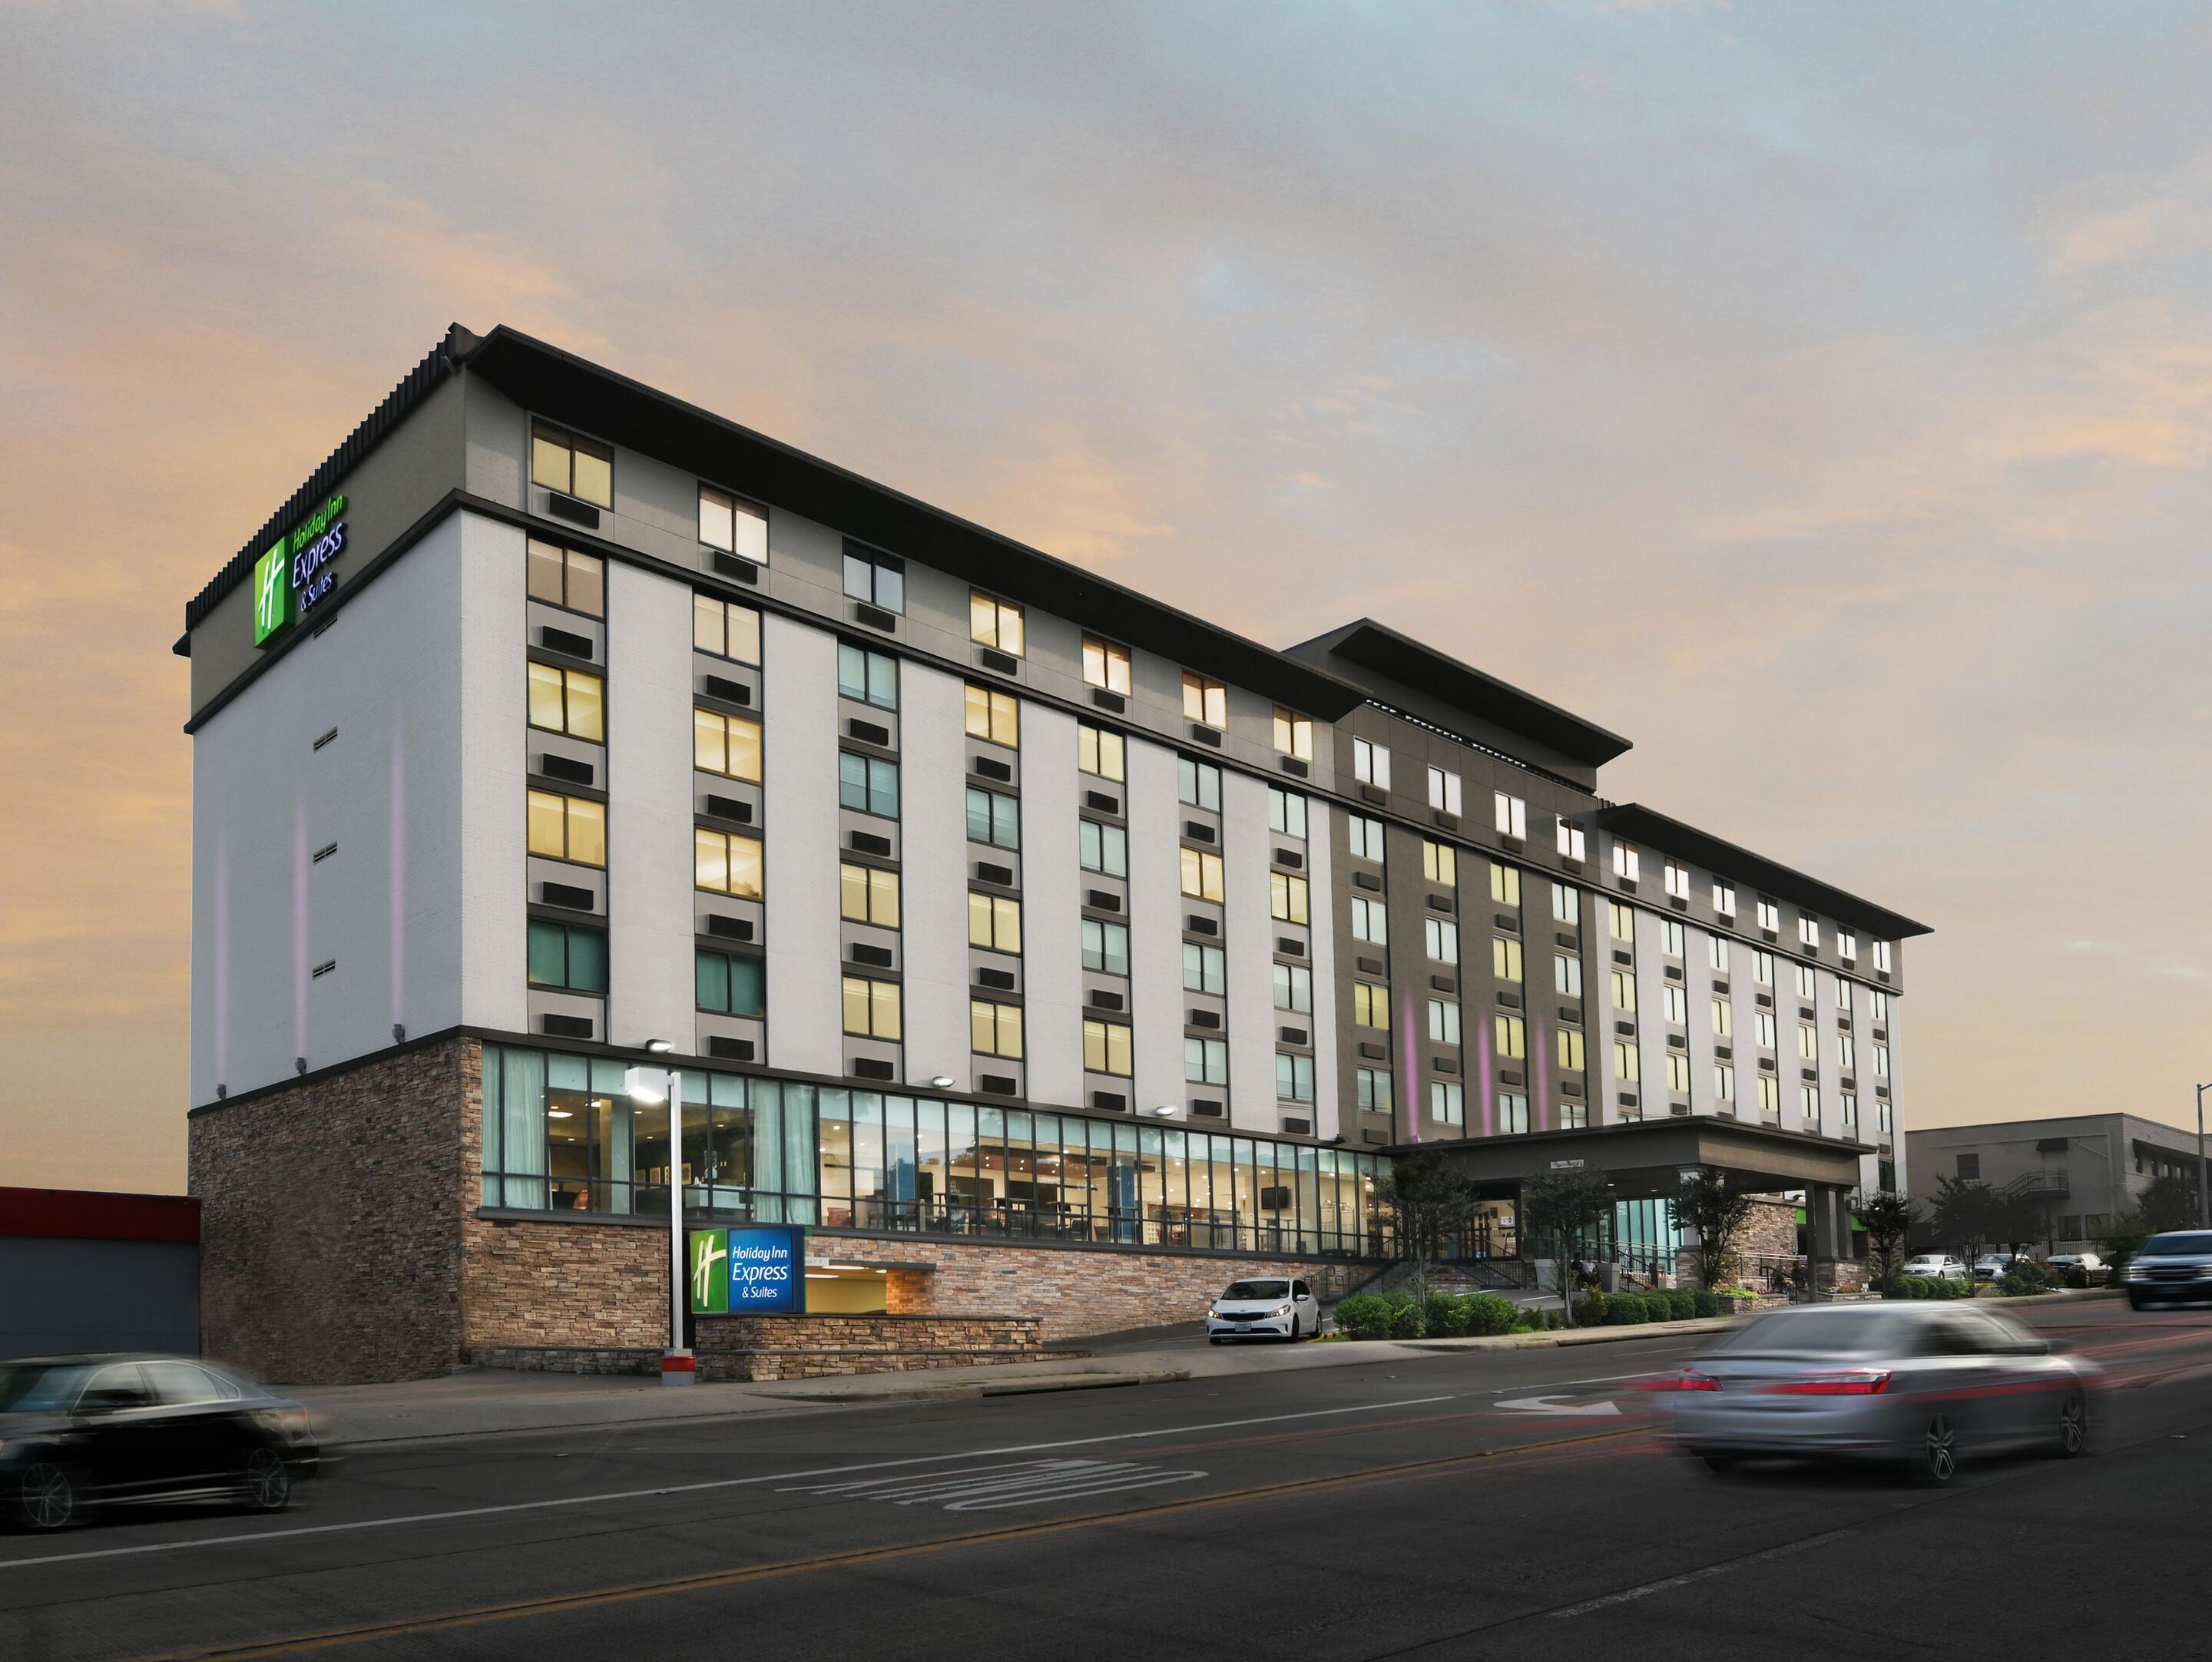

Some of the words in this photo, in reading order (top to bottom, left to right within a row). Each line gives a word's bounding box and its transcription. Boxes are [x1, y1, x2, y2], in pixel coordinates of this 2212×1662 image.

[293, 510, 326, 553] Holiday
[327, 495, 343, 521] Inn
[293, 522, 342, 588] Express
[300, 591, 306, 612] &
[307, 571, 333, 607] Suites
[732, 1245, 770, 1262] Holiday
[771, 1245, 787, 1258] Inn
[732, 1262, 788, 1286] Express
[742, 1286, 750, 1298] &
[750, 1286, 778, 1298] Suites
